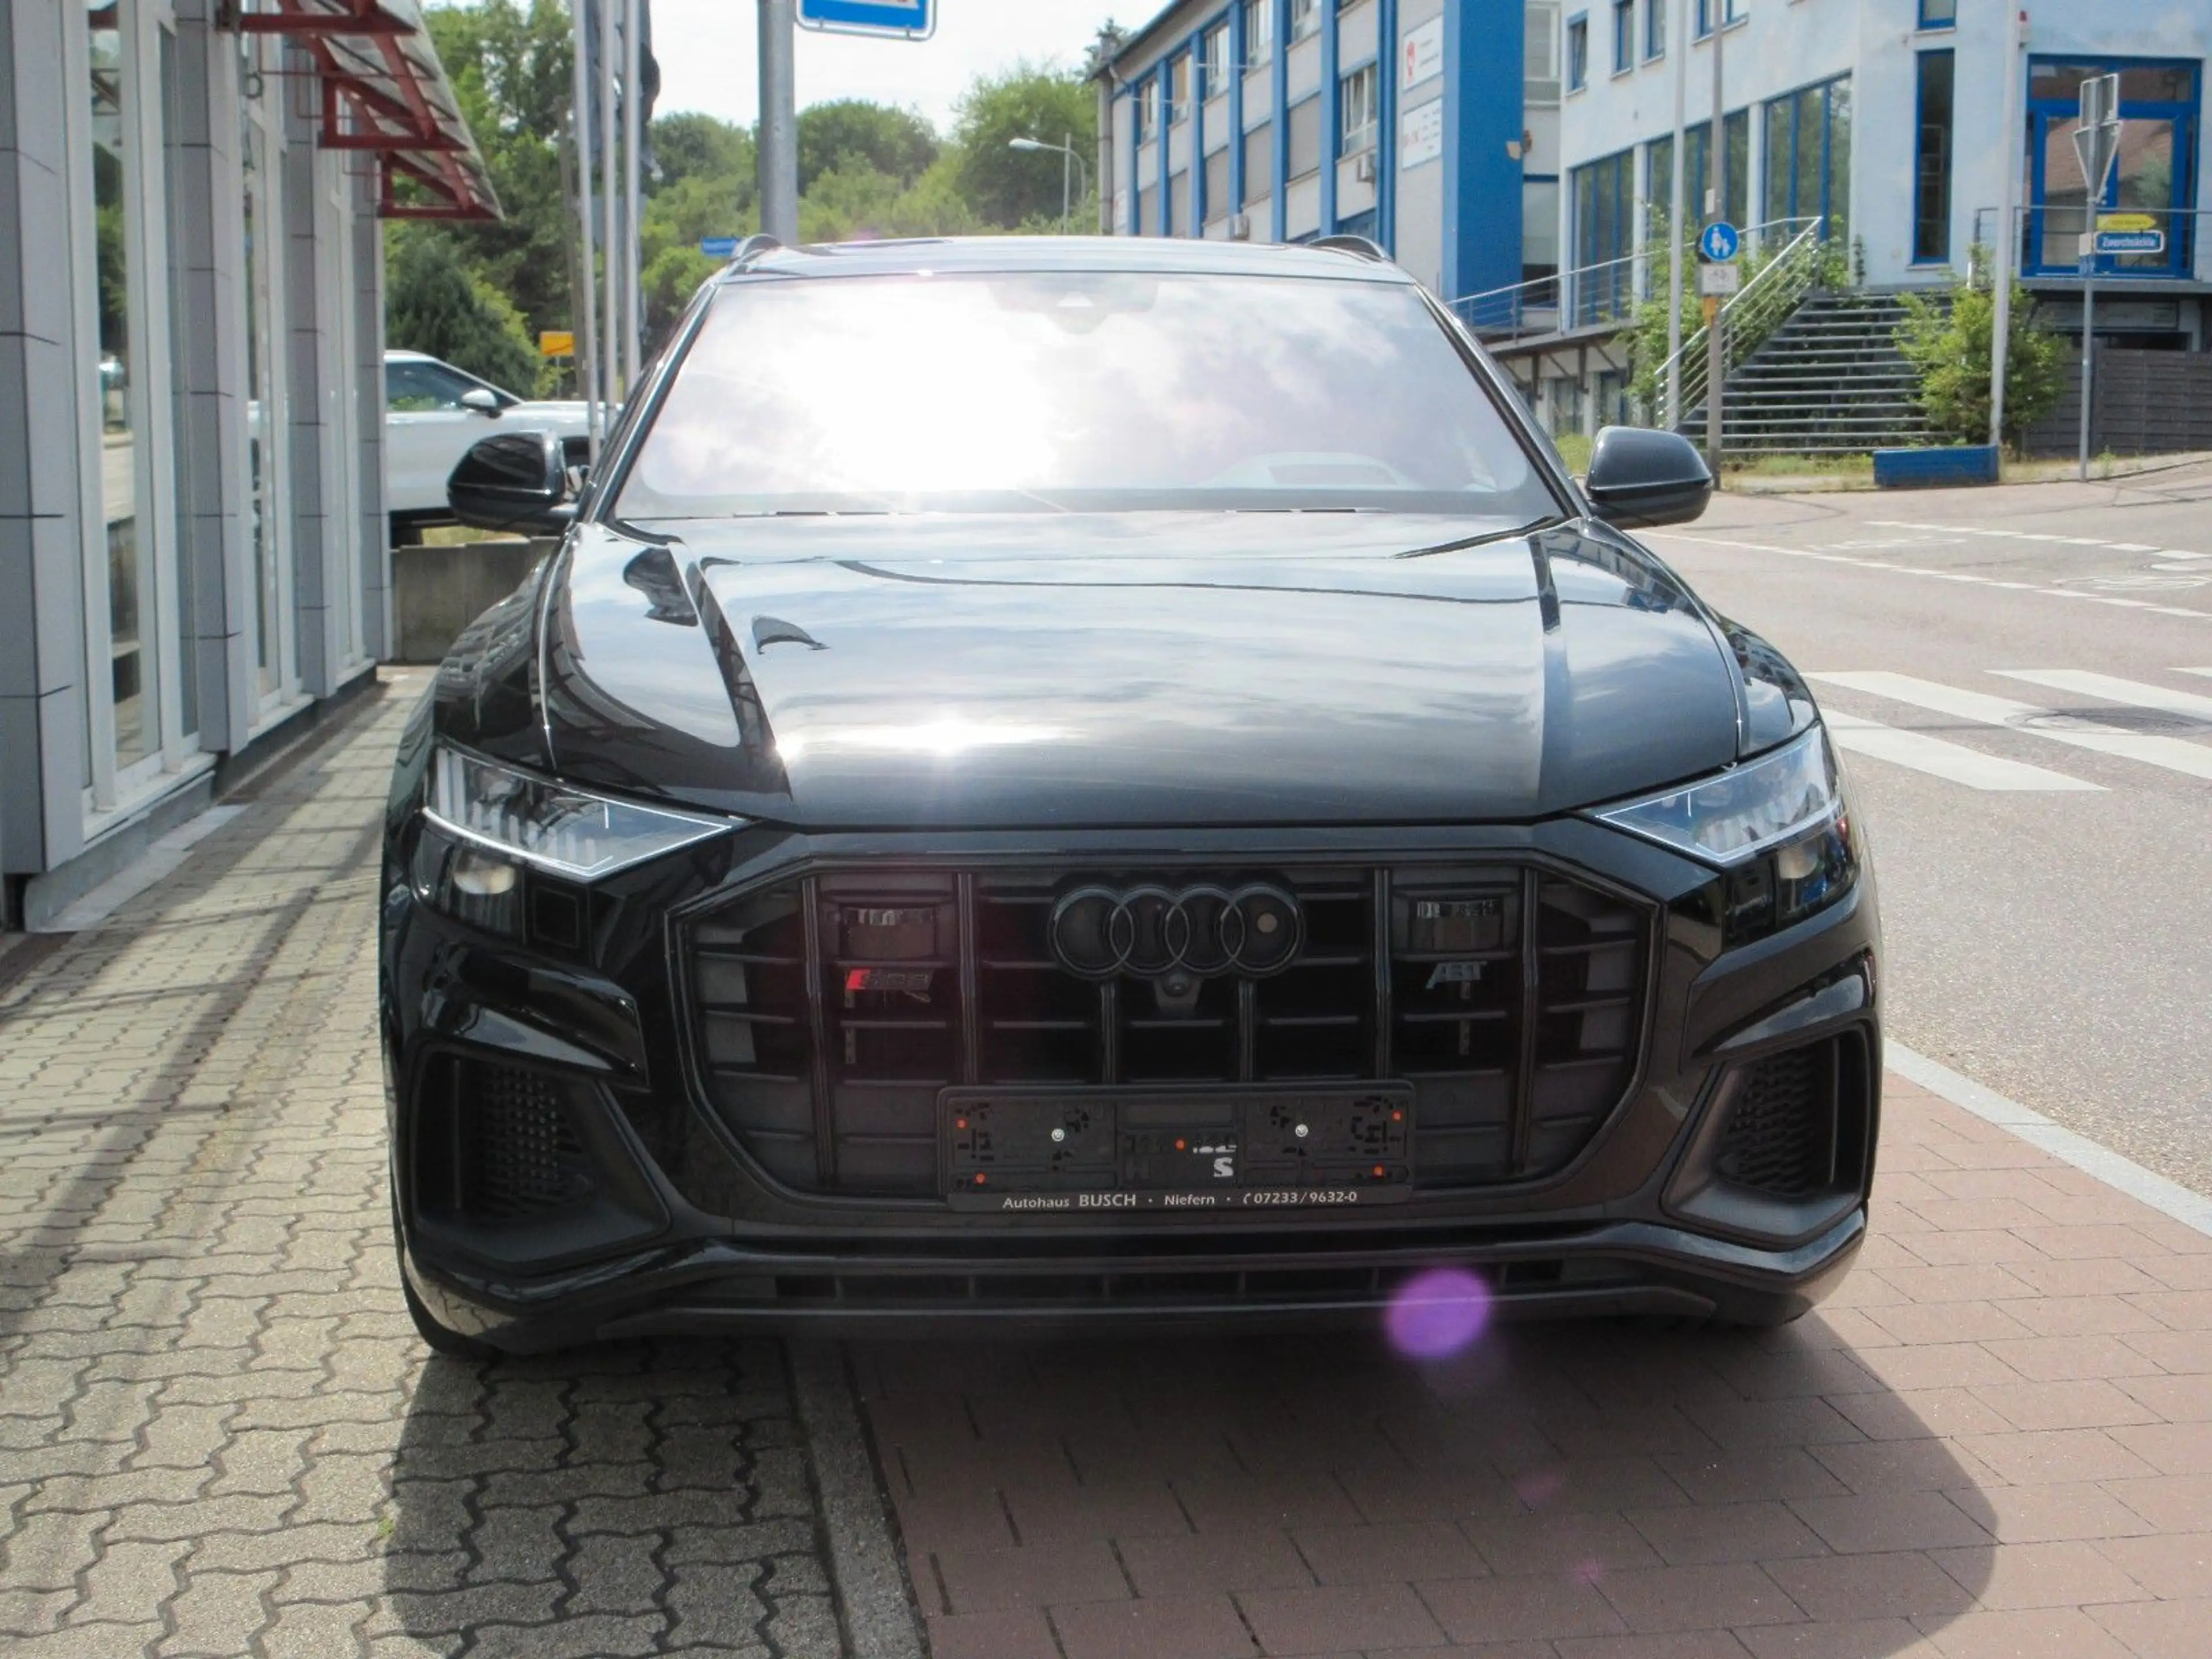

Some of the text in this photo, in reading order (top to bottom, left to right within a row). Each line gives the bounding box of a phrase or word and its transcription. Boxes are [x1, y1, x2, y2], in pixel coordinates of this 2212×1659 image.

[1002, 1196, 1070, 1209] Autohaus
[1078, 1193, 1137, 1207] BUSCH
[1164, 1194, 1215, 1206] Niefern
